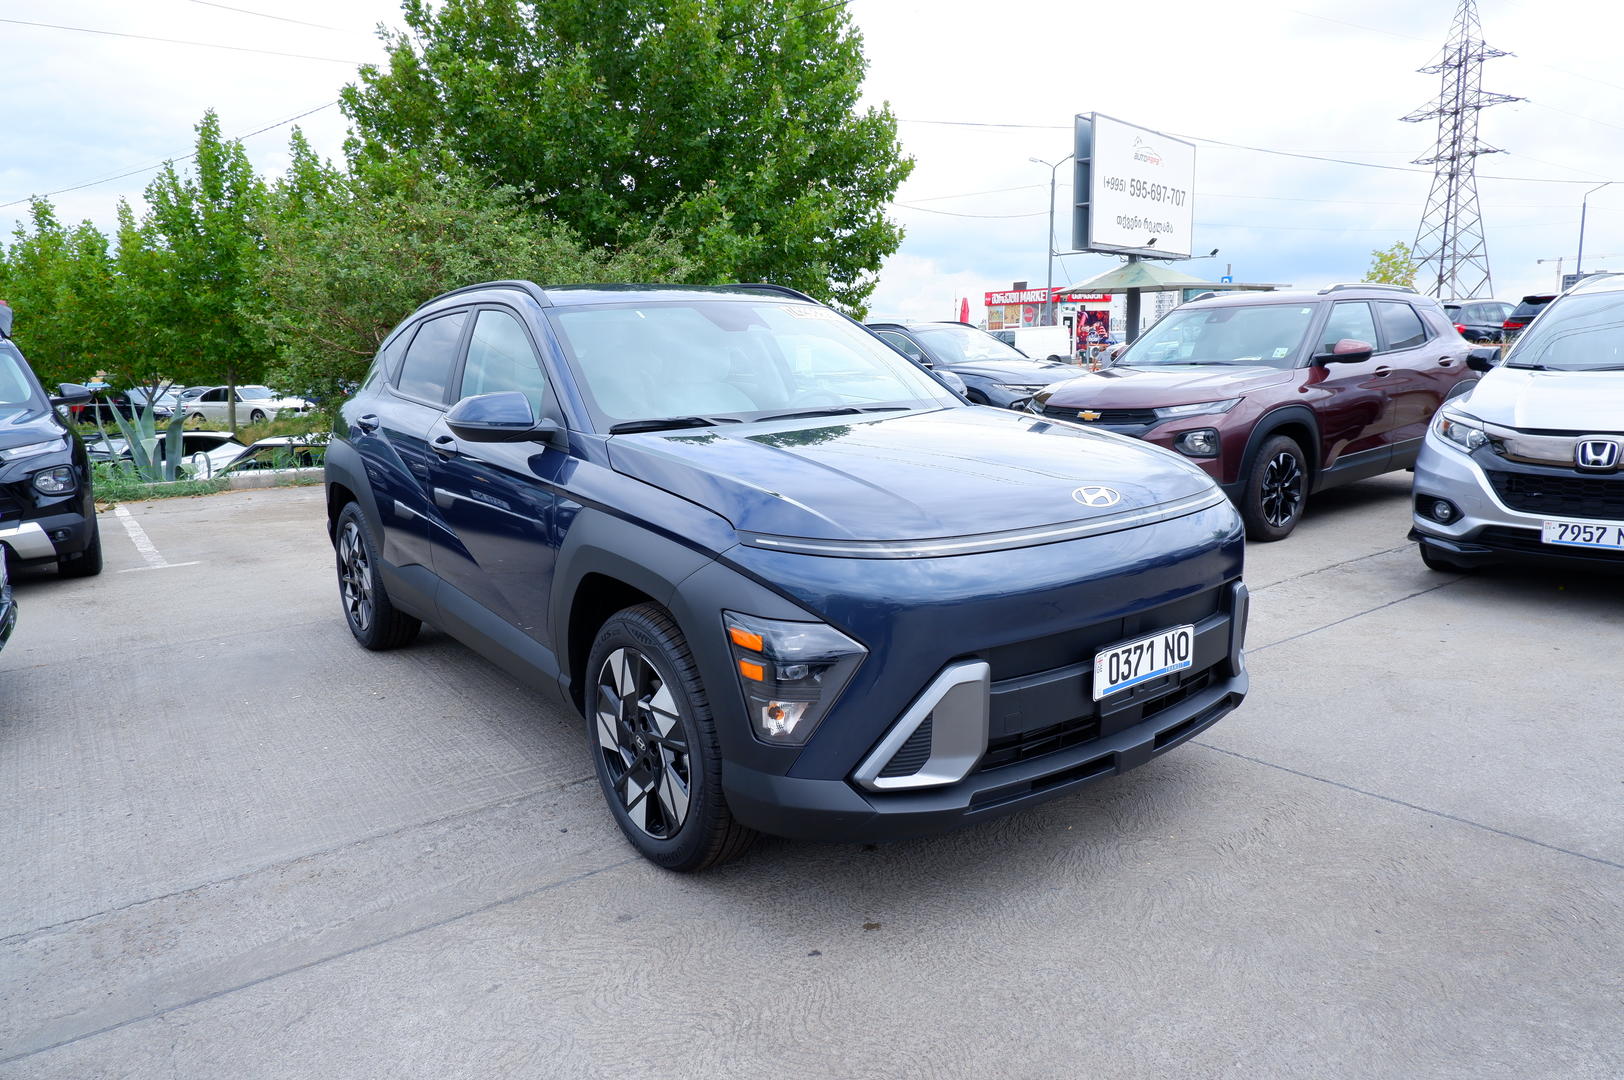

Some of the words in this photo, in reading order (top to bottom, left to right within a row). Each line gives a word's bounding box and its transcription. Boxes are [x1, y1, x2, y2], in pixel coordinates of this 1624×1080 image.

[1103, 175, 1126, 193] (+995)
[1129, 178, 1186, 207] 595-697-707
[1558, 523, 1607, 544] 7957
[1108, 640, 1155, 685] 0371
[1164, 631, 1190, 667] NO
